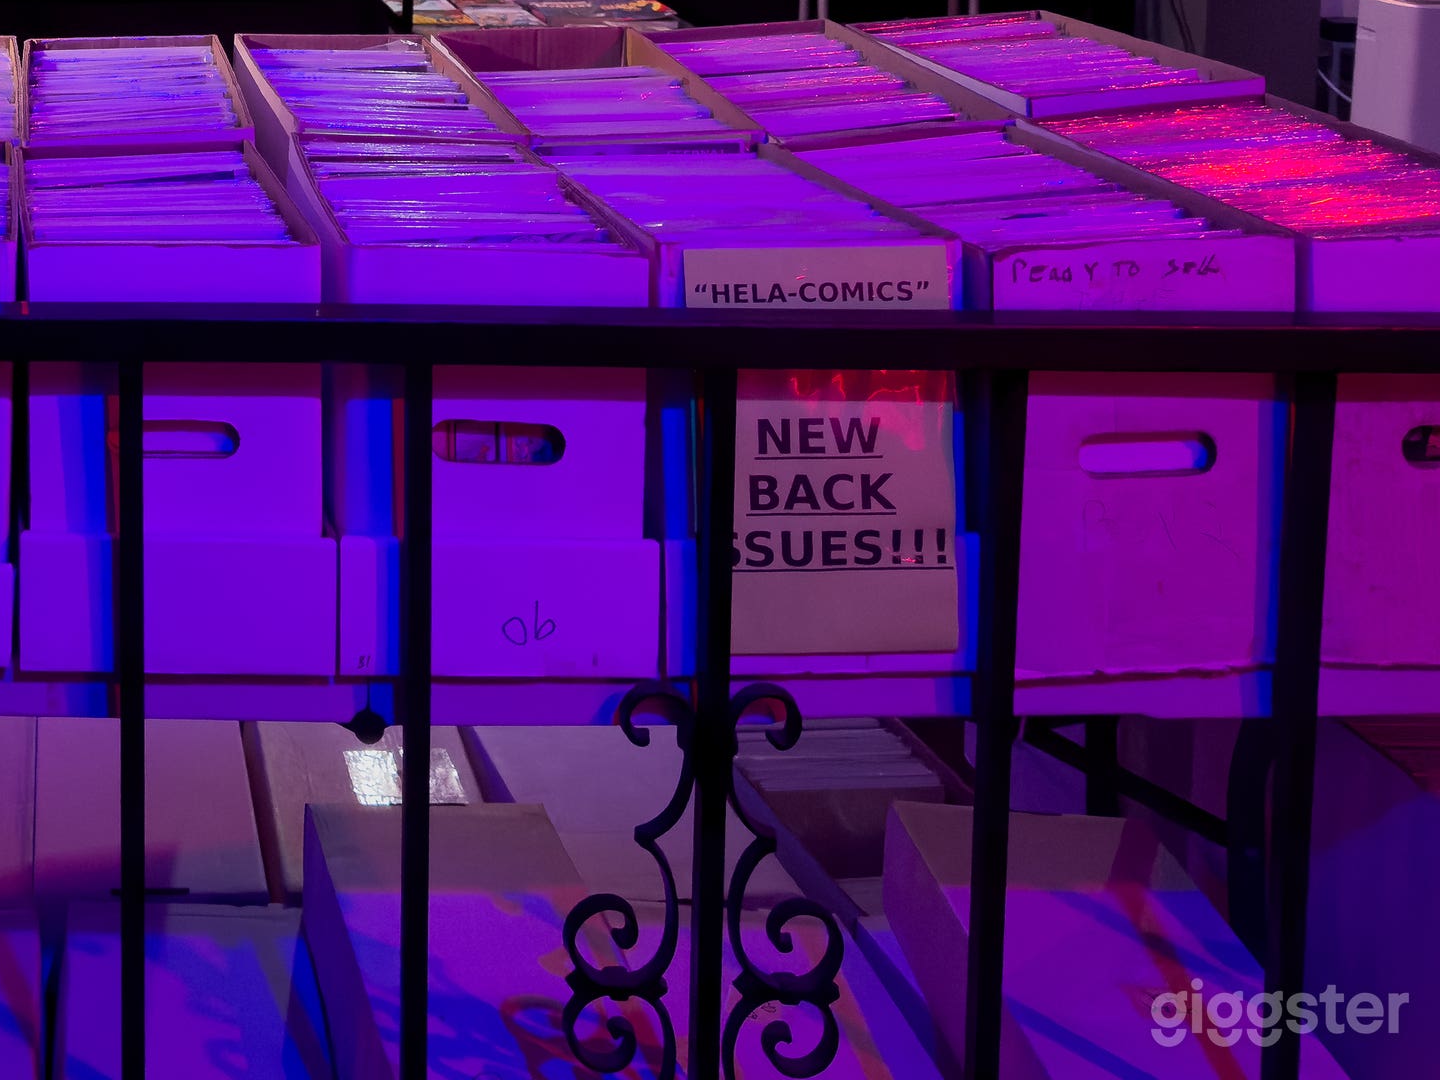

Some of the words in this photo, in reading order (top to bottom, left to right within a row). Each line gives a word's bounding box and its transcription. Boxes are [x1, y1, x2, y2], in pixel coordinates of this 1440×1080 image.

[694, 280, 930, 305] “HELA-COMICS”
[756, 417, 881, 456] NEW
[748, 472, 898, 512] BACK
[732, 528, 949, 568] SUES!!!
